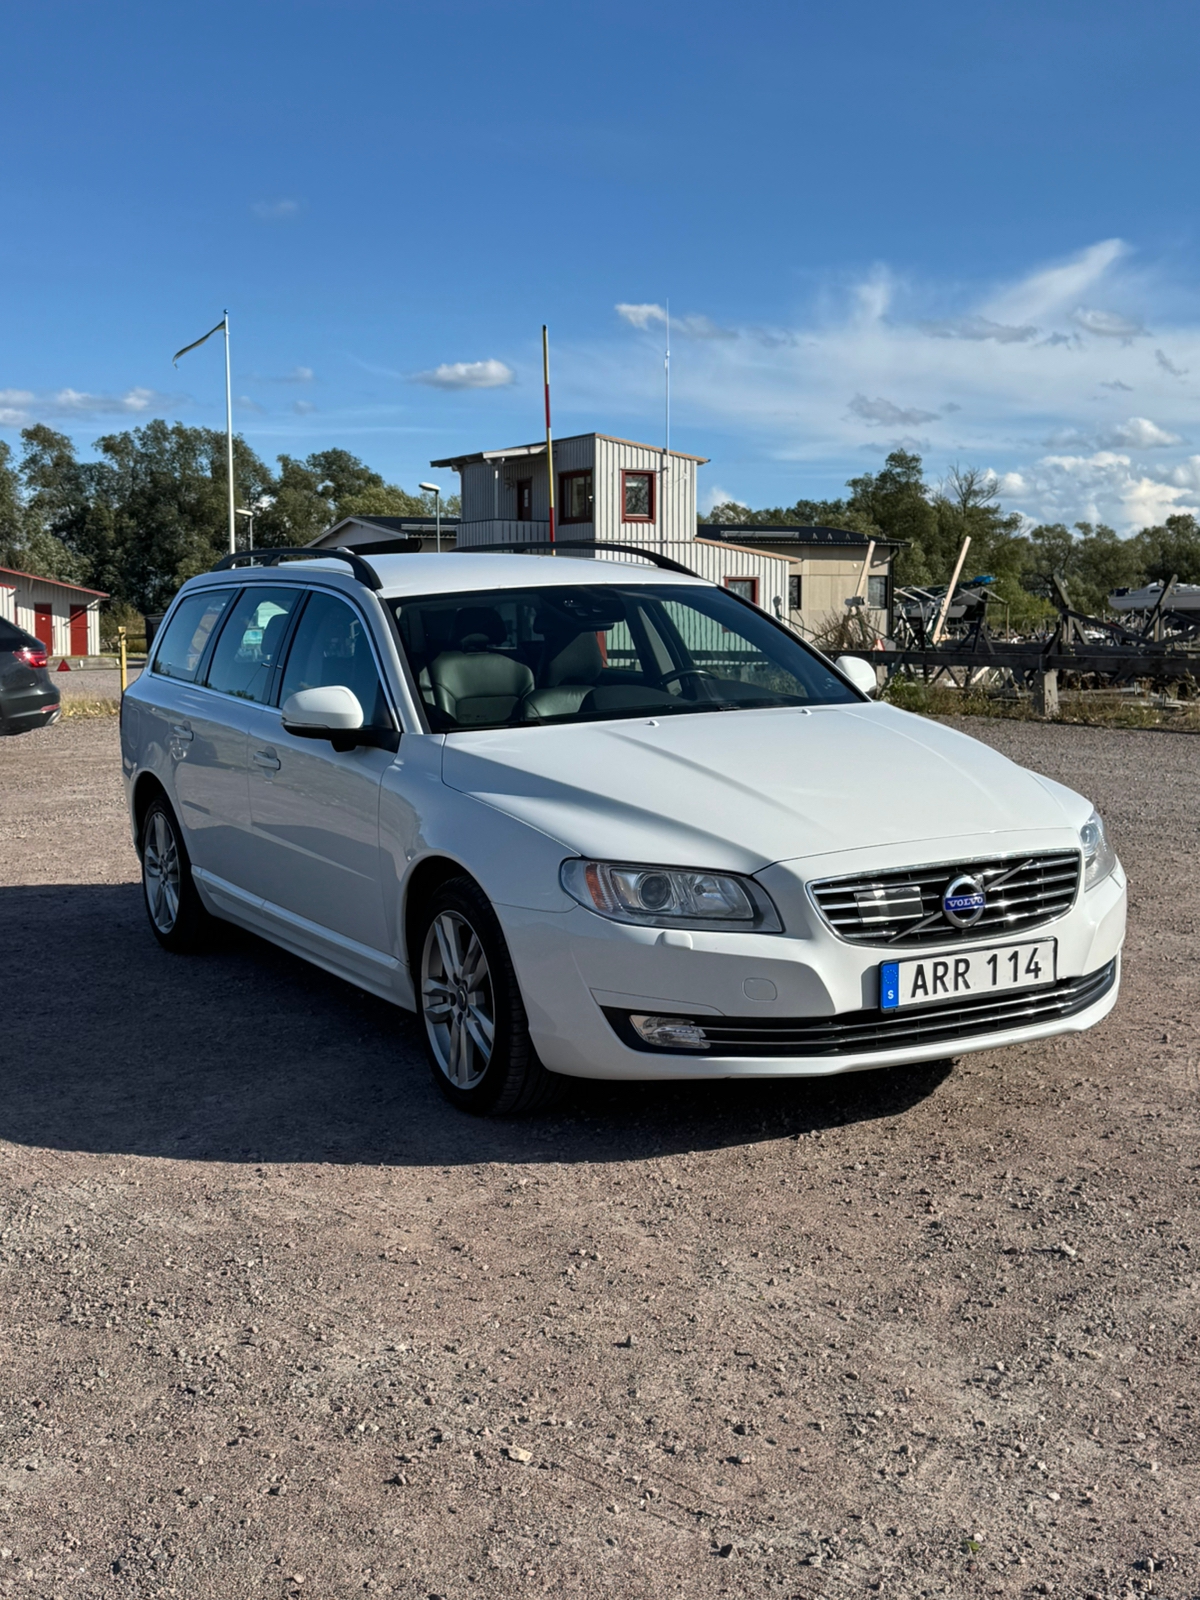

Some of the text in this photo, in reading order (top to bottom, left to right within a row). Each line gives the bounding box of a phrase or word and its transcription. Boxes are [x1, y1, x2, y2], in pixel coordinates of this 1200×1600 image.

[947, 896, 984, 908] VOLVO
[911, 947, 1042, 998] ARR 114
[887, 990, 894, 999] S
